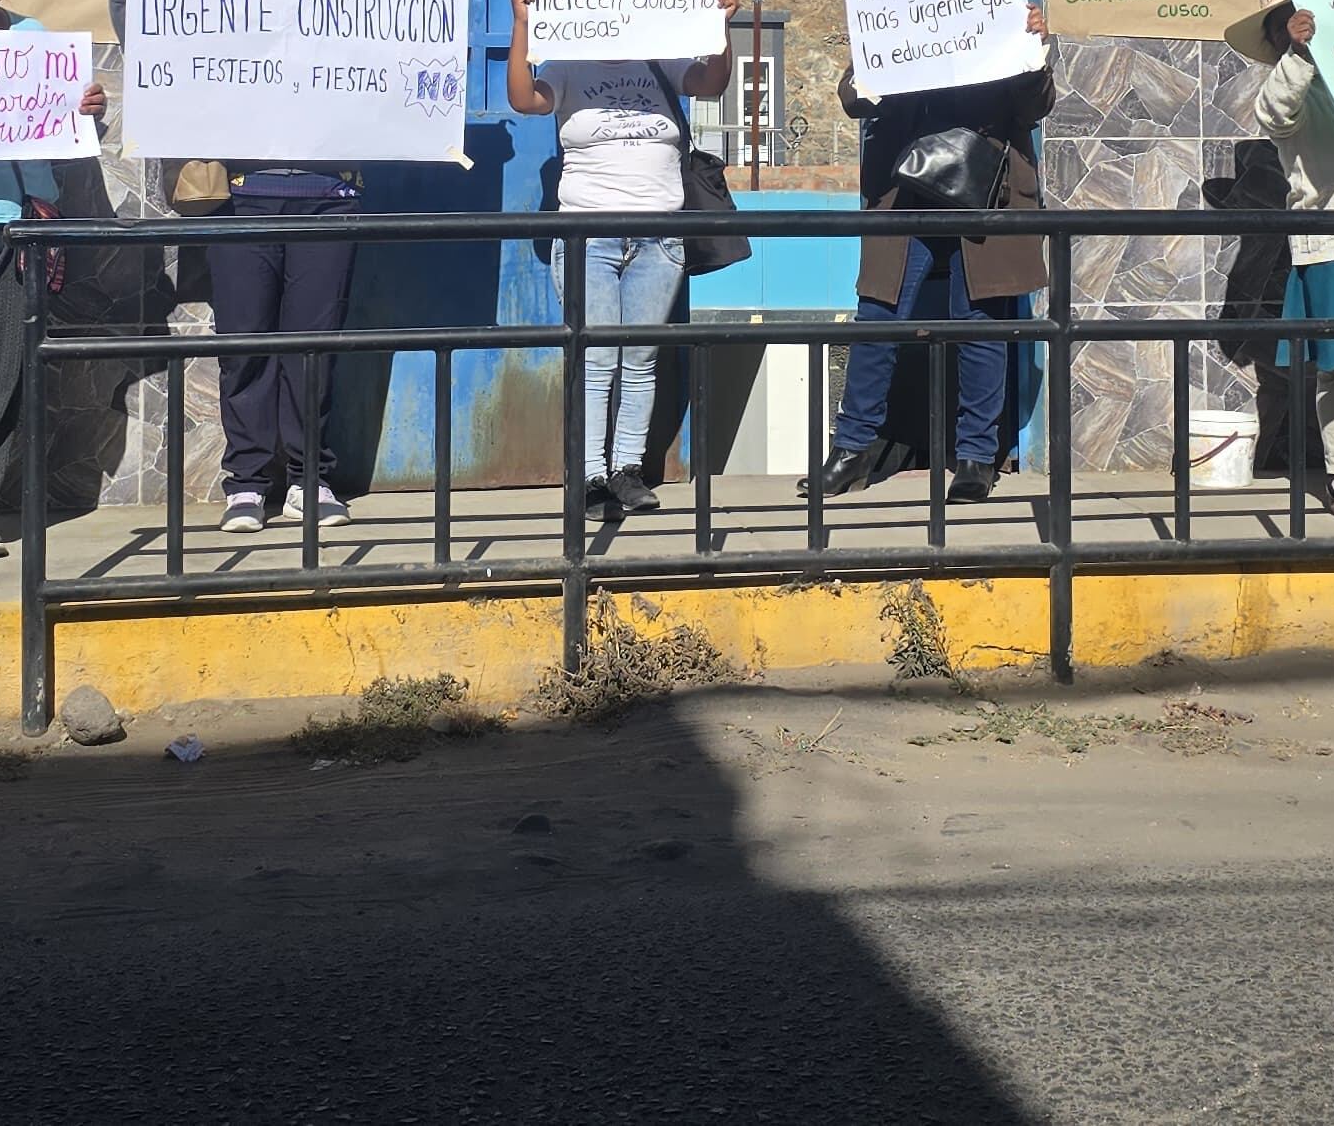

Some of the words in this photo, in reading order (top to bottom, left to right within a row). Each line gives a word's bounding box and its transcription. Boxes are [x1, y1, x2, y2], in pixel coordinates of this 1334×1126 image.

[857, 7, 899, 33] más
[1157, 4, 1213, 18] CUSCO.
[45, 44, 79, 81] mi
[862, 42, 883, 70] la
[137, 61, 173, 88] LOS
[192, 57, 283, 84] FESTEJOS
[312, 66, 388, 93] FIESTAS
